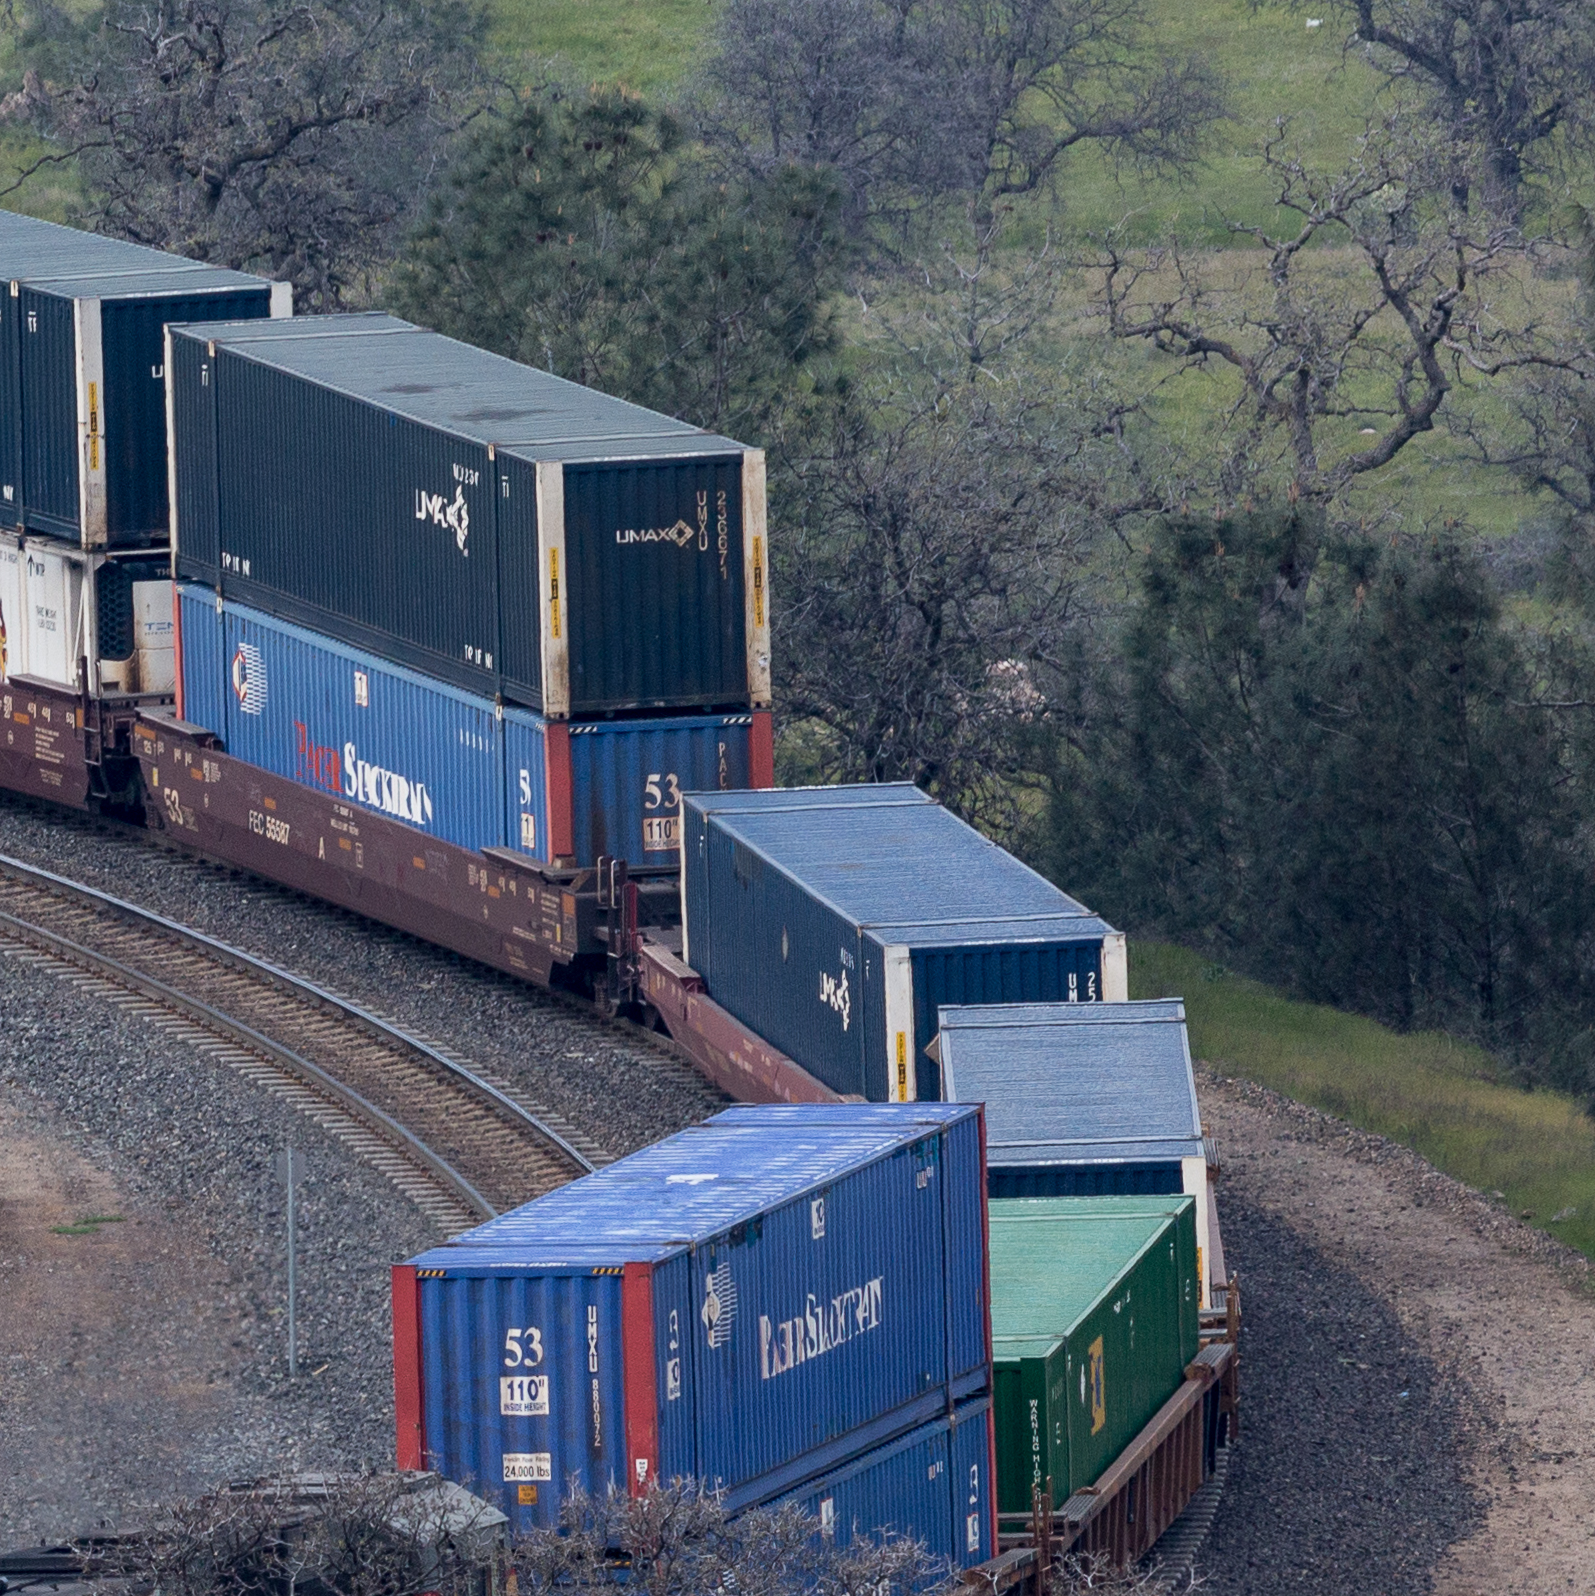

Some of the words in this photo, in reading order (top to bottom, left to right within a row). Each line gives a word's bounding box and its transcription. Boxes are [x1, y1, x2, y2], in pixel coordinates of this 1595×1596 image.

[616, 529, 671, 543] UMAX
[719, 741, 727, 790] PAC
[164, 787, 184, 825] 53
[645, 773, 680, 809] 53
[249, 809, 264, 836] FEC
[318, 837, 325, 860] A
[504, 1327, 544, 1367] 53
[587, 1305, 598, 1372] UMXU
[507, 1379, 545, 1401] 110"
[591, 1379, 601, 1447] 880072
[1029, 1400, 1040, 1451] WARNING
[537, 1465, 550, 1477] lbs
